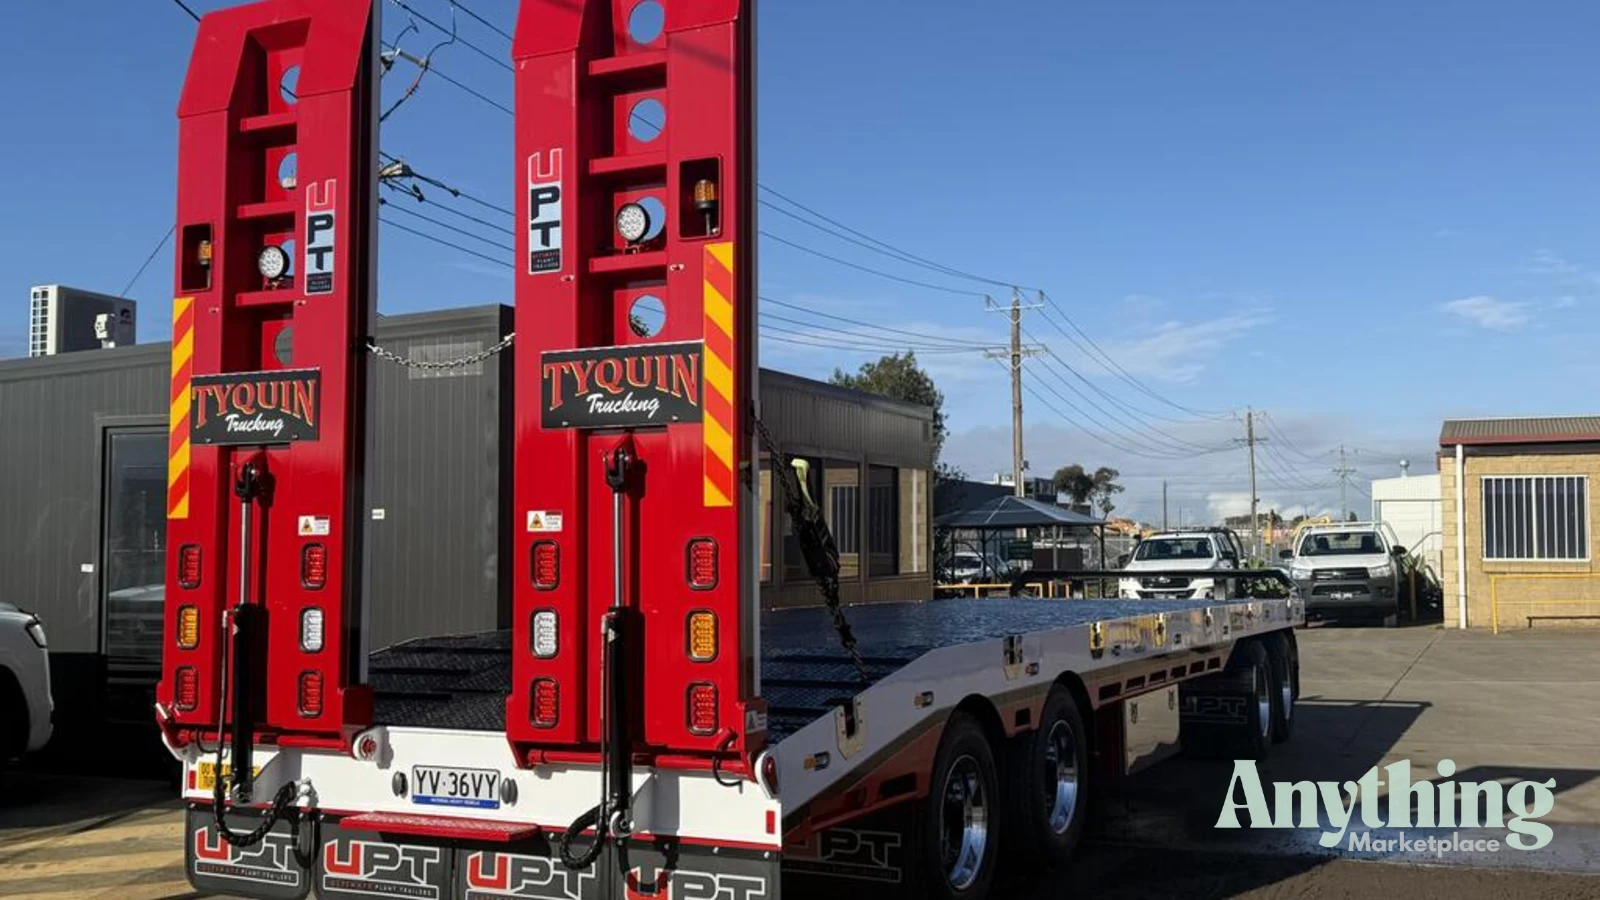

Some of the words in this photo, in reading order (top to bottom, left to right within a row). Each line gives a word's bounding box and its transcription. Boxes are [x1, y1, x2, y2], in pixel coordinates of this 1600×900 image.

[527, 148, 562, 247] UPT
[305, 179, 336, 270] UPT
[192, 379, 316, 429] TYQUIN
[543, 353, 699, 411] TYQUIN
[586, 392, 660, 419] Trucking
[225, 413, 285, 437] Trucking
[324, 839, 440, 884] UPT
[467, 851, 596, 900] UPT
